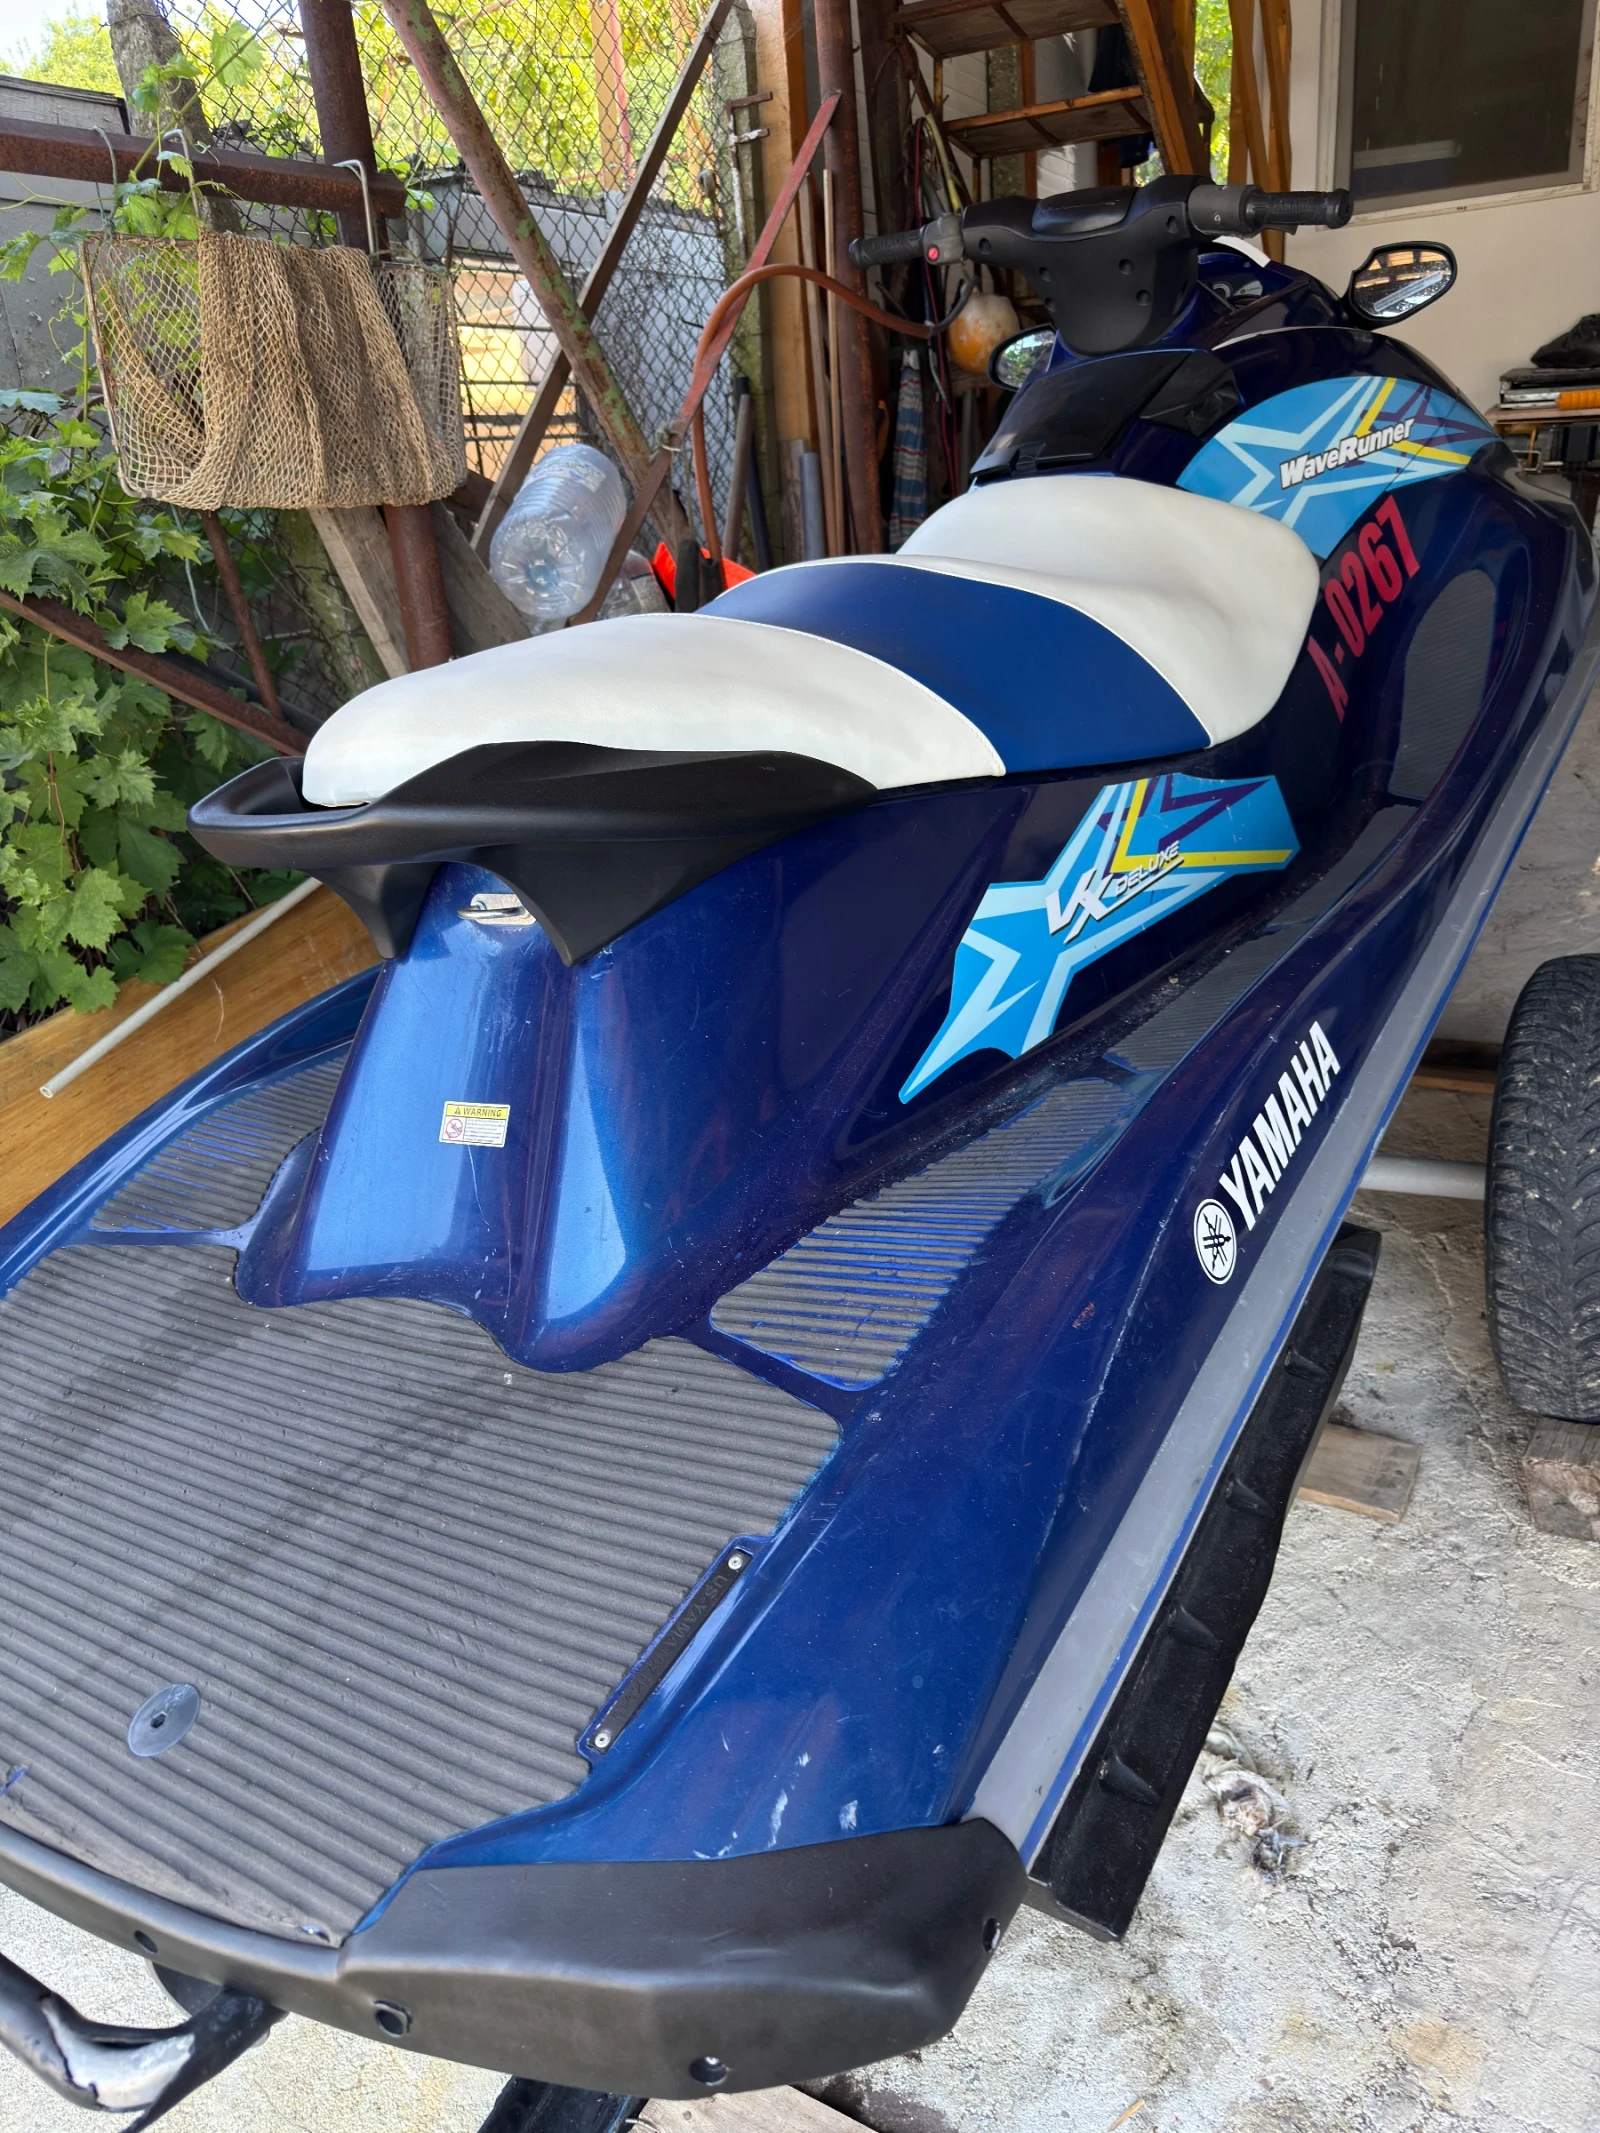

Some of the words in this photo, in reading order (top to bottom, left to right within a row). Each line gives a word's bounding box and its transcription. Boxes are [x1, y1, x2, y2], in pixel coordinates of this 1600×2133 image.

[1280, 418, 1416, 490] WaveRunner
[1307, 494, 1420, 724] A-0267
[1115, 840, 1181, 898] DELUXE
[463, 1107, 502, 1117] WARNING
[1219, 1021, 1341, 1231] YAMAHA
